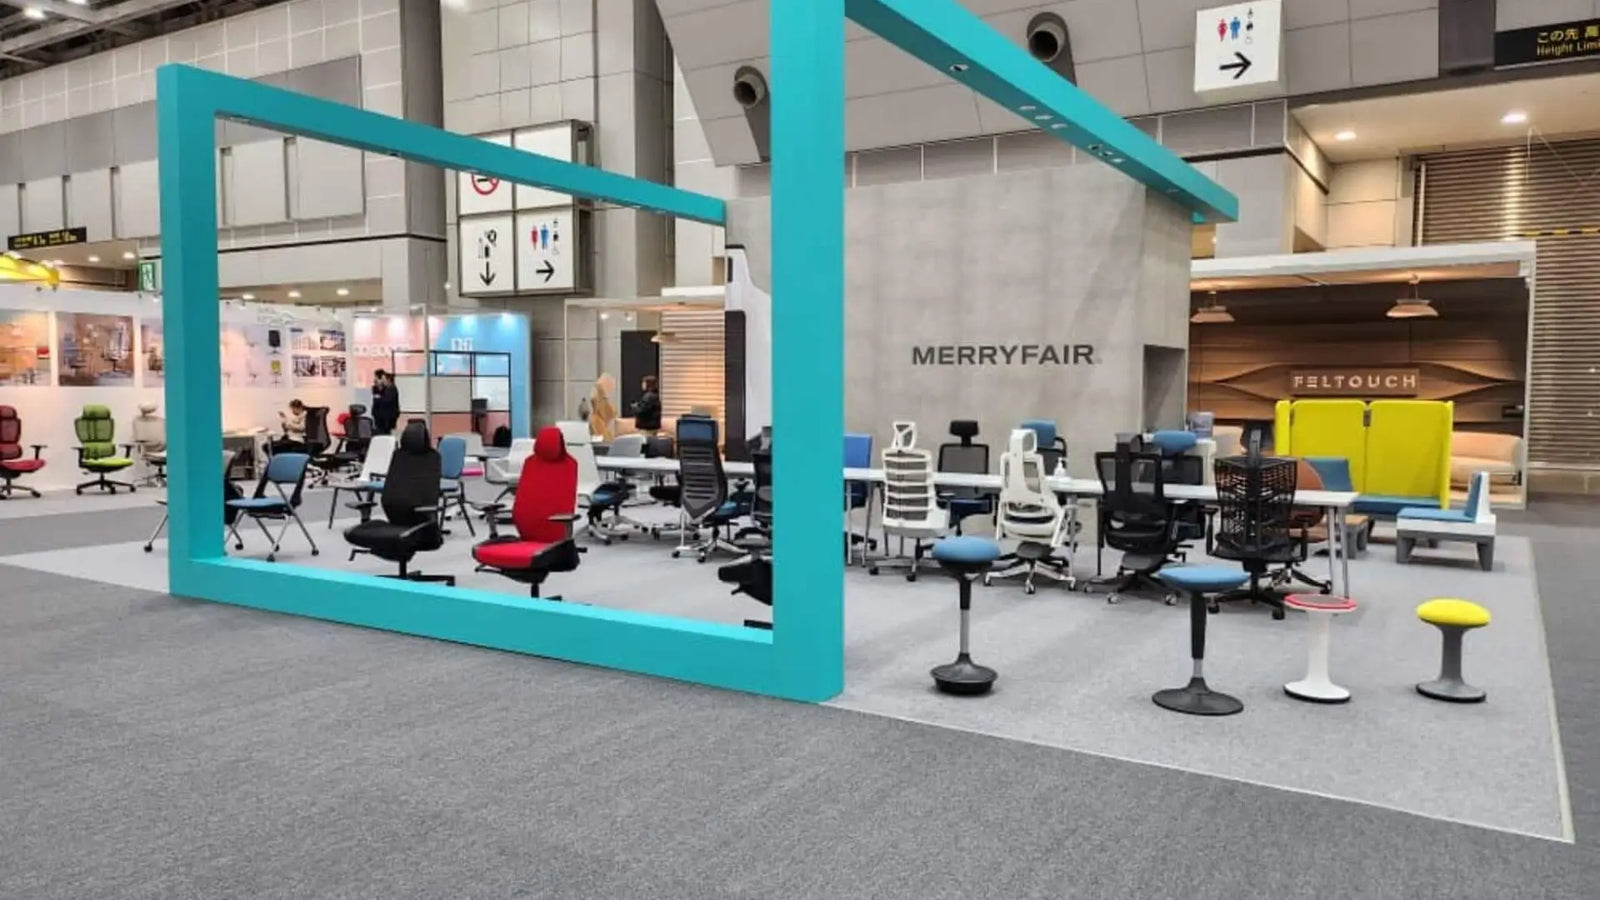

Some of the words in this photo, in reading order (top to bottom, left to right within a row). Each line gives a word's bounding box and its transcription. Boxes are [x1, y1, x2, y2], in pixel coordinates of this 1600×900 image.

[1537, 28, 1579, 43] この先
[1536, 43, 1574, 56] Height
[912, 344, 1095, 365] MERRYFAIR
[1293, 374, 1416, 389] FELTOUCH
